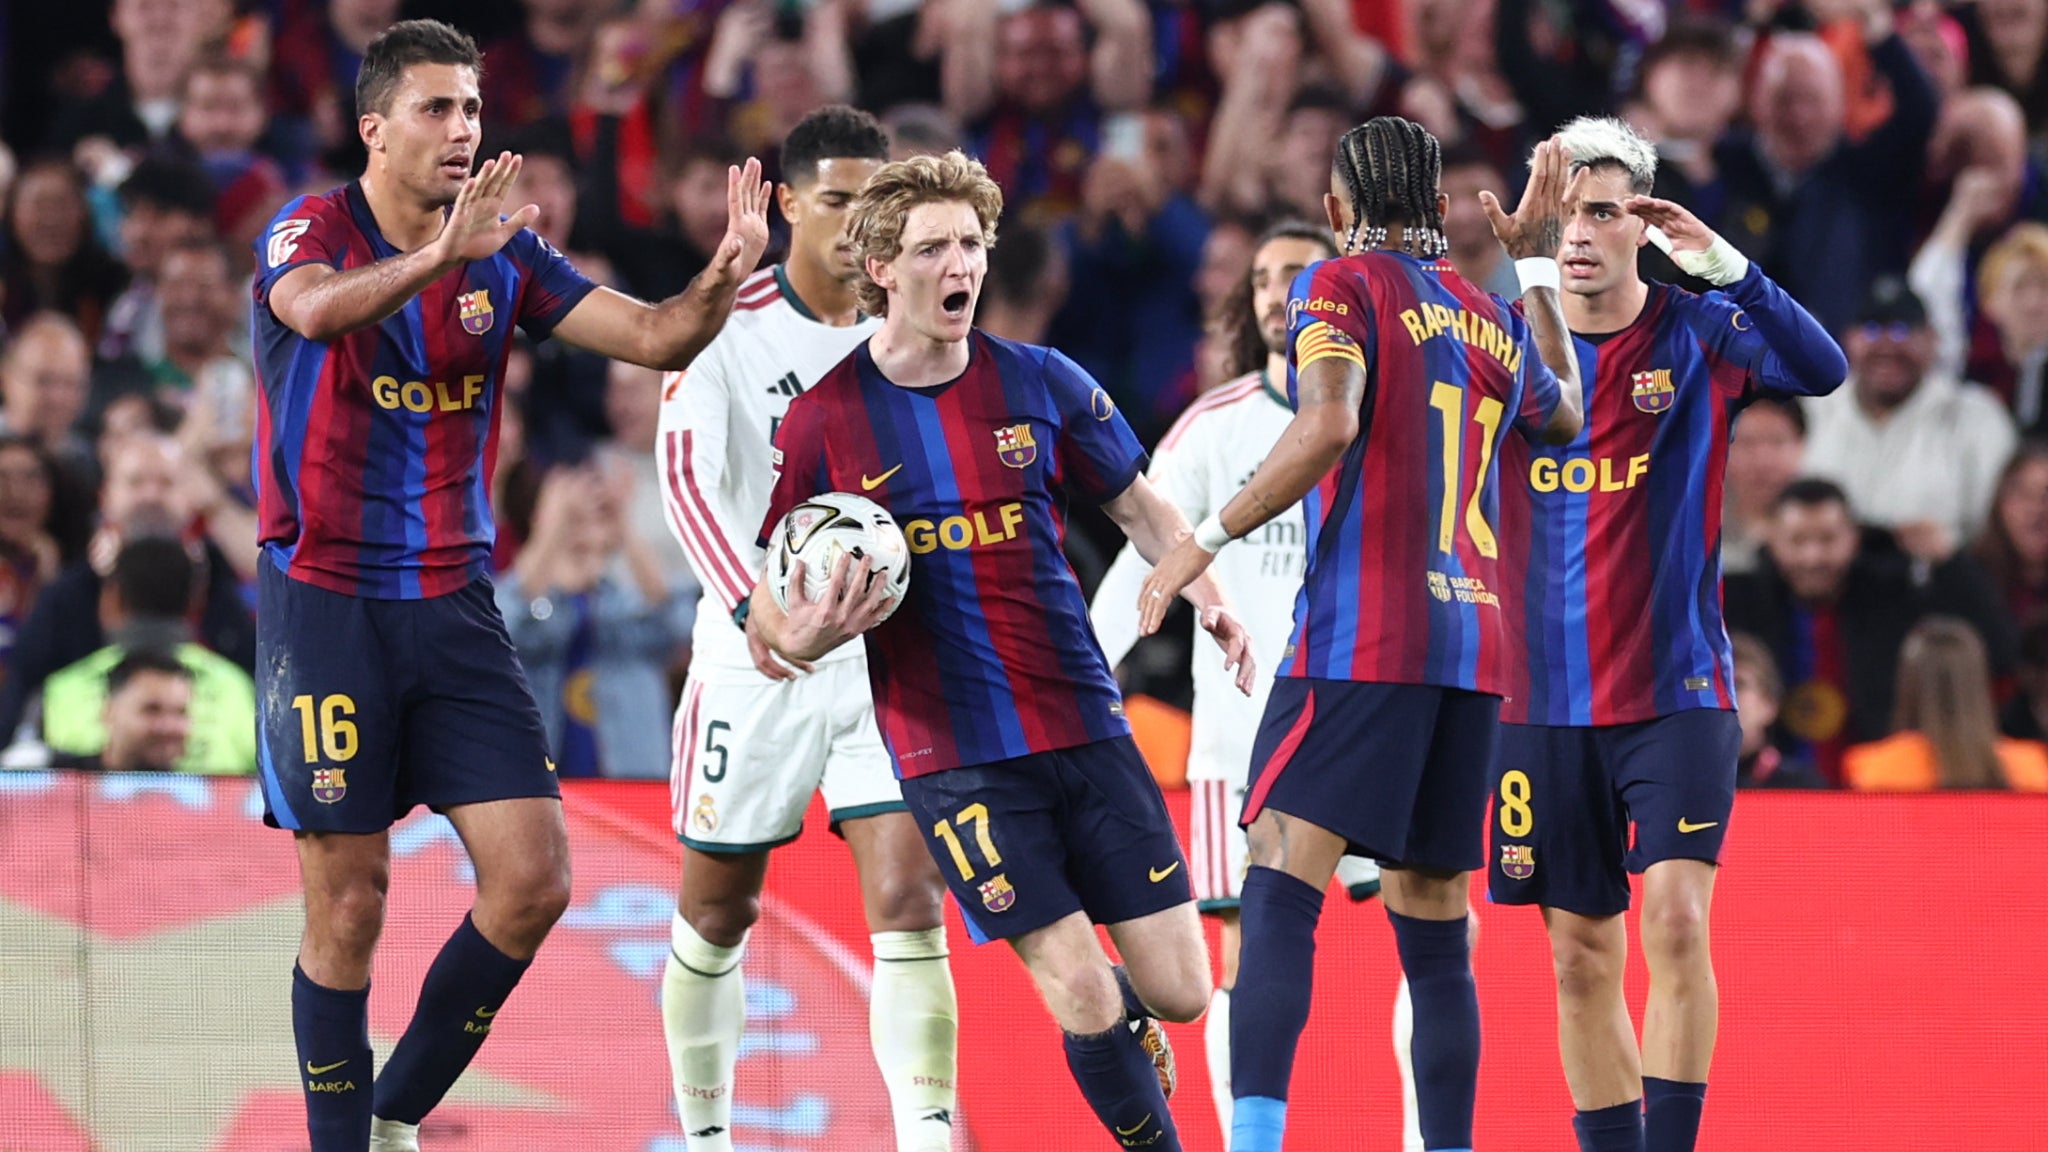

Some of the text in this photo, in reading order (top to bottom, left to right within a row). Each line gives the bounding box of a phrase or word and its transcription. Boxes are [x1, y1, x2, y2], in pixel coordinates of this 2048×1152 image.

[372, 374, 485, 413] GOLF
[1529, 452, 1650, 493] GOLF
[904, 502, 1024, 554] GOLF
[291, 693, 360, 764] 16
[703, 719, 732, 784] 5
[1500, 769, 1534, 838] 8
[934, 802, 1003, 883] 17
[308, 1079, 356, 1094] BARÇA
